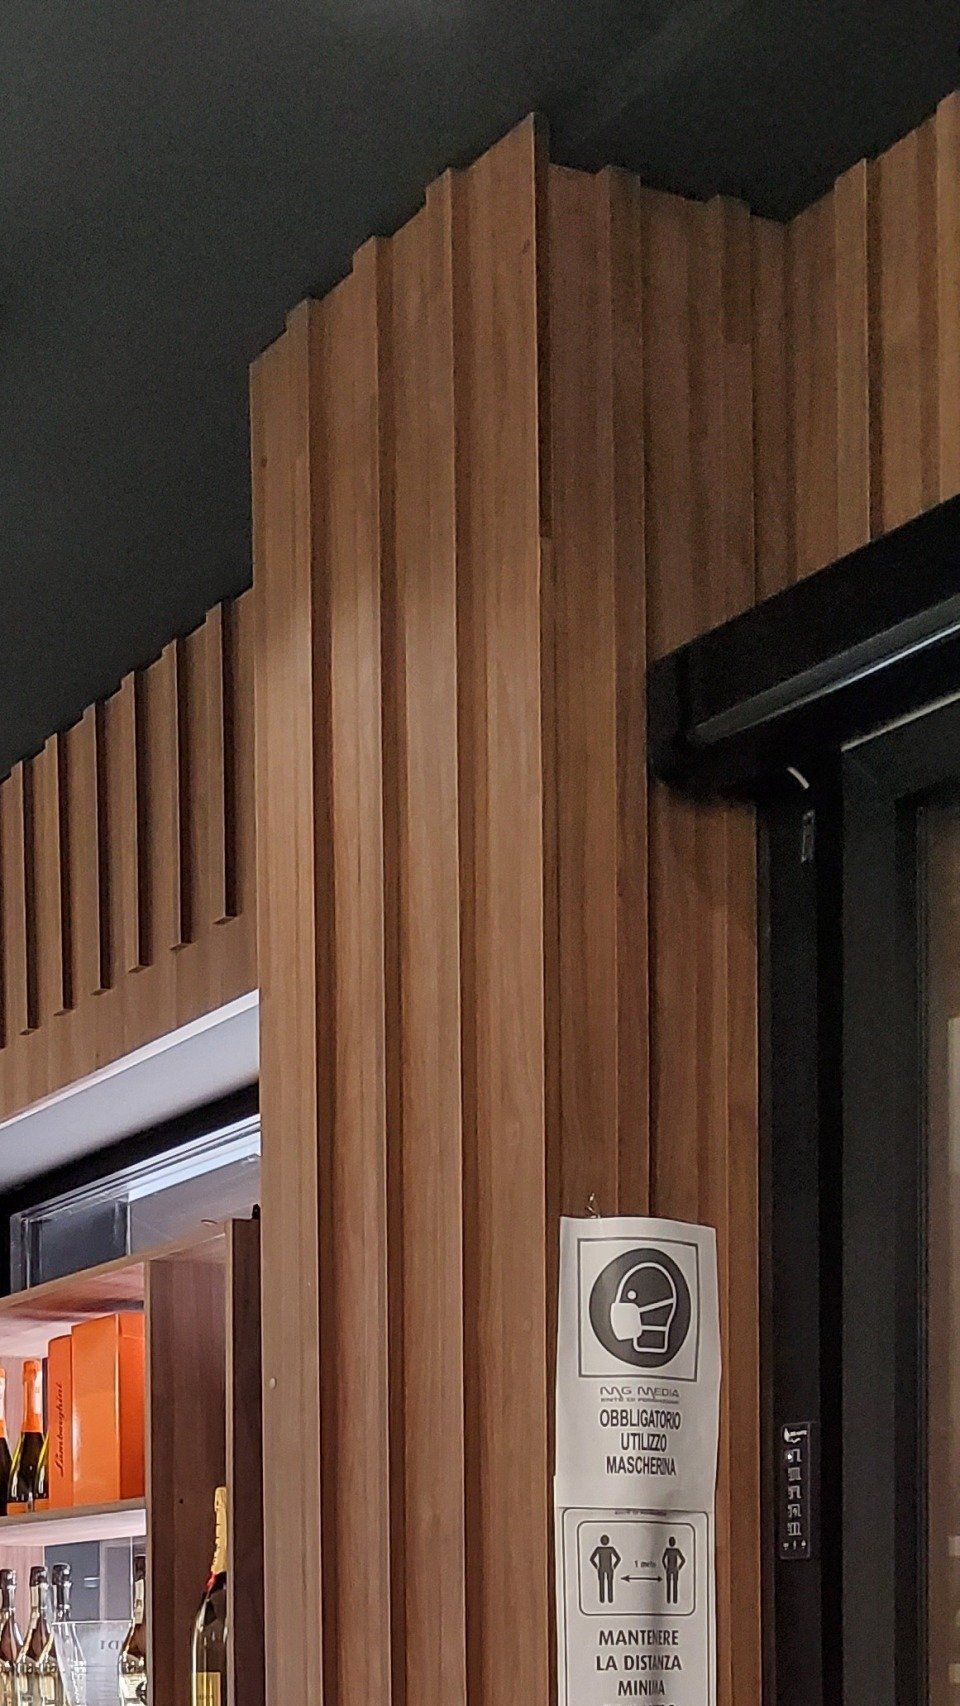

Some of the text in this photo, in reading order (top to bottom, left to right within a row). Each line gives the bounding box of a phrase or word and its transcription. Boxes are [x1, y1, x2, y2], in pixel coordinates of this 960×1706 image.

[637, 1386, 679, 1399] MEDIA
[600, 1409, 681, 1430] OBBLIGATORIO
[621, 1432, 667, 1452] UTILIZZO
[606, 1456, 677, 1476] MASCHERINA
[598, 1630, 679, 1646] MANTENERE
[596, 1655, 682, 1671] LA DISTANZA
[617, 1680, 665, 1696] MINIMA
